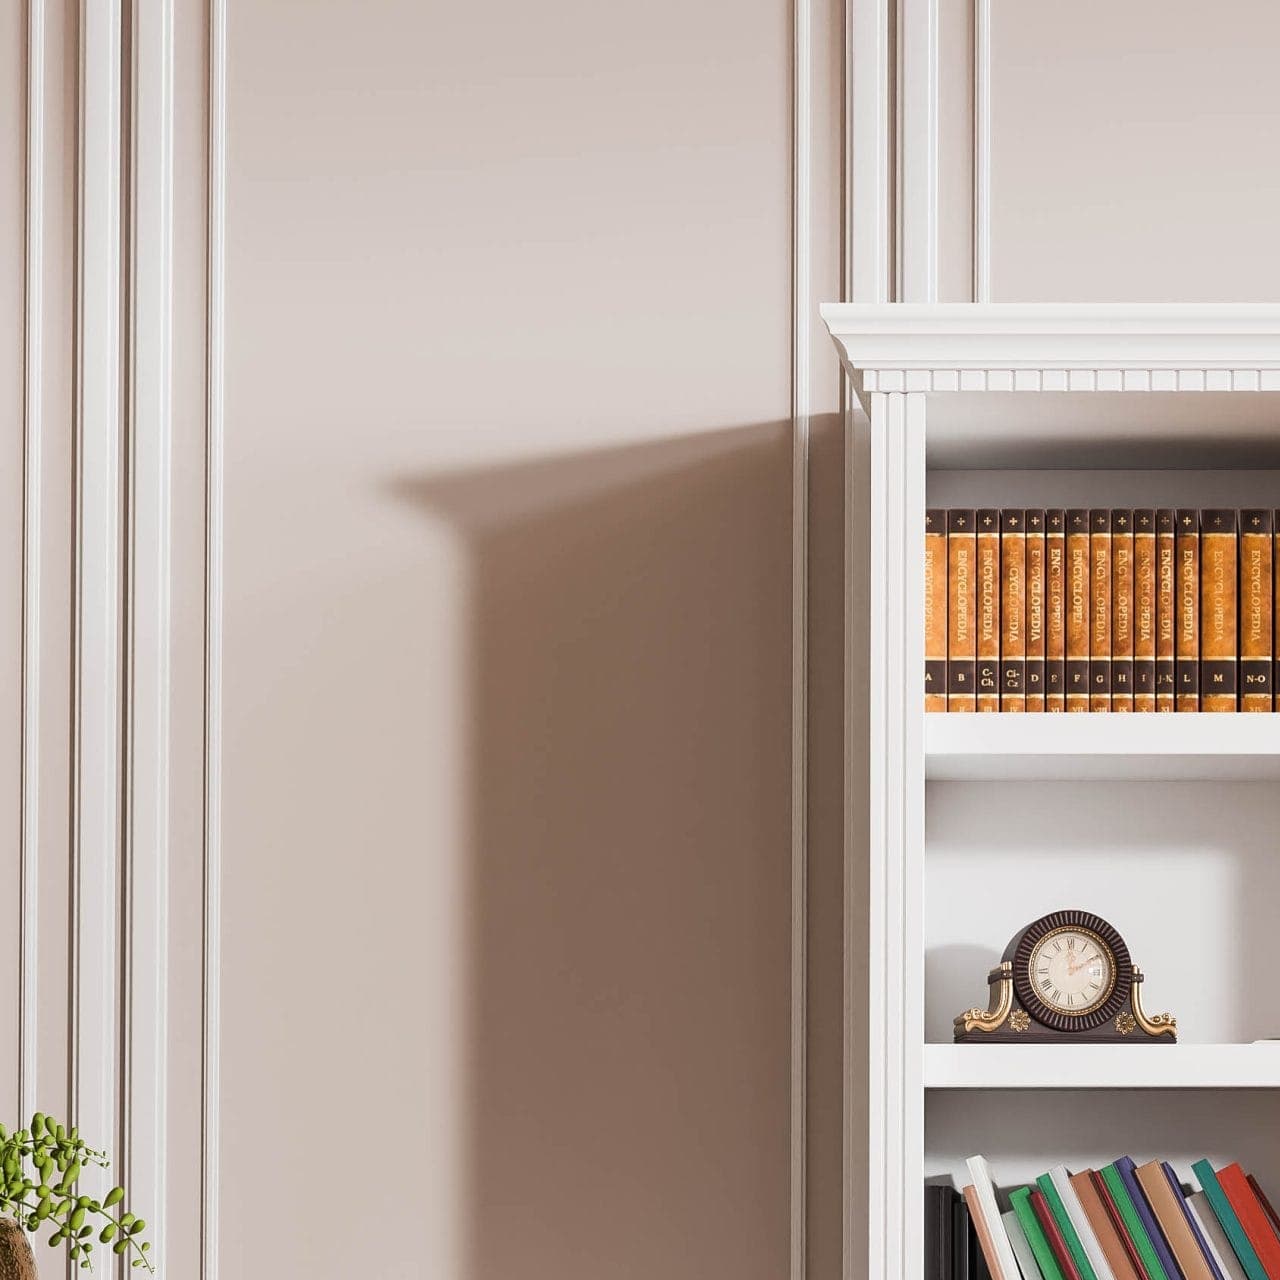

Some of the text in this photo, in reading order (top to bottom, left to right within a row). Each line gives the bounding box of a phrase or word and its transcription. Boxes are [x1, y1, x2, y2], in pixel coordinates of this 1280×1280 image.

[958, 550, 968, 641] ENCYCLOPEDIA
[983, 549, 992, 640] ENCYCLOPEDIA
[1031, 550, 1040, 641] ENCYCLOPEDIA
[1118, 550, 1128, 640] ENCYLOPEDIA
[1183, 550, 1193, 641] ENCYCLOPEDIA
[1214, 551, 1223, 641] ENCYCLOPEDIA
[1251, 550, 1261, 641] ENCYCLOPEDIA
[958, 674, 965, 682] B
[1031, 674, 1039, 682] D
[1074, 674, 1081, 682] F
[1096, 675, 1104, 683] G
[1118, 674, 1126, 682] H
[1183, 674, 1191, 682] L
[1213, 674, 1223, 682] M
[1246, 675, 1266, 683] N-O
[981, 678, 994, 687] Ch
